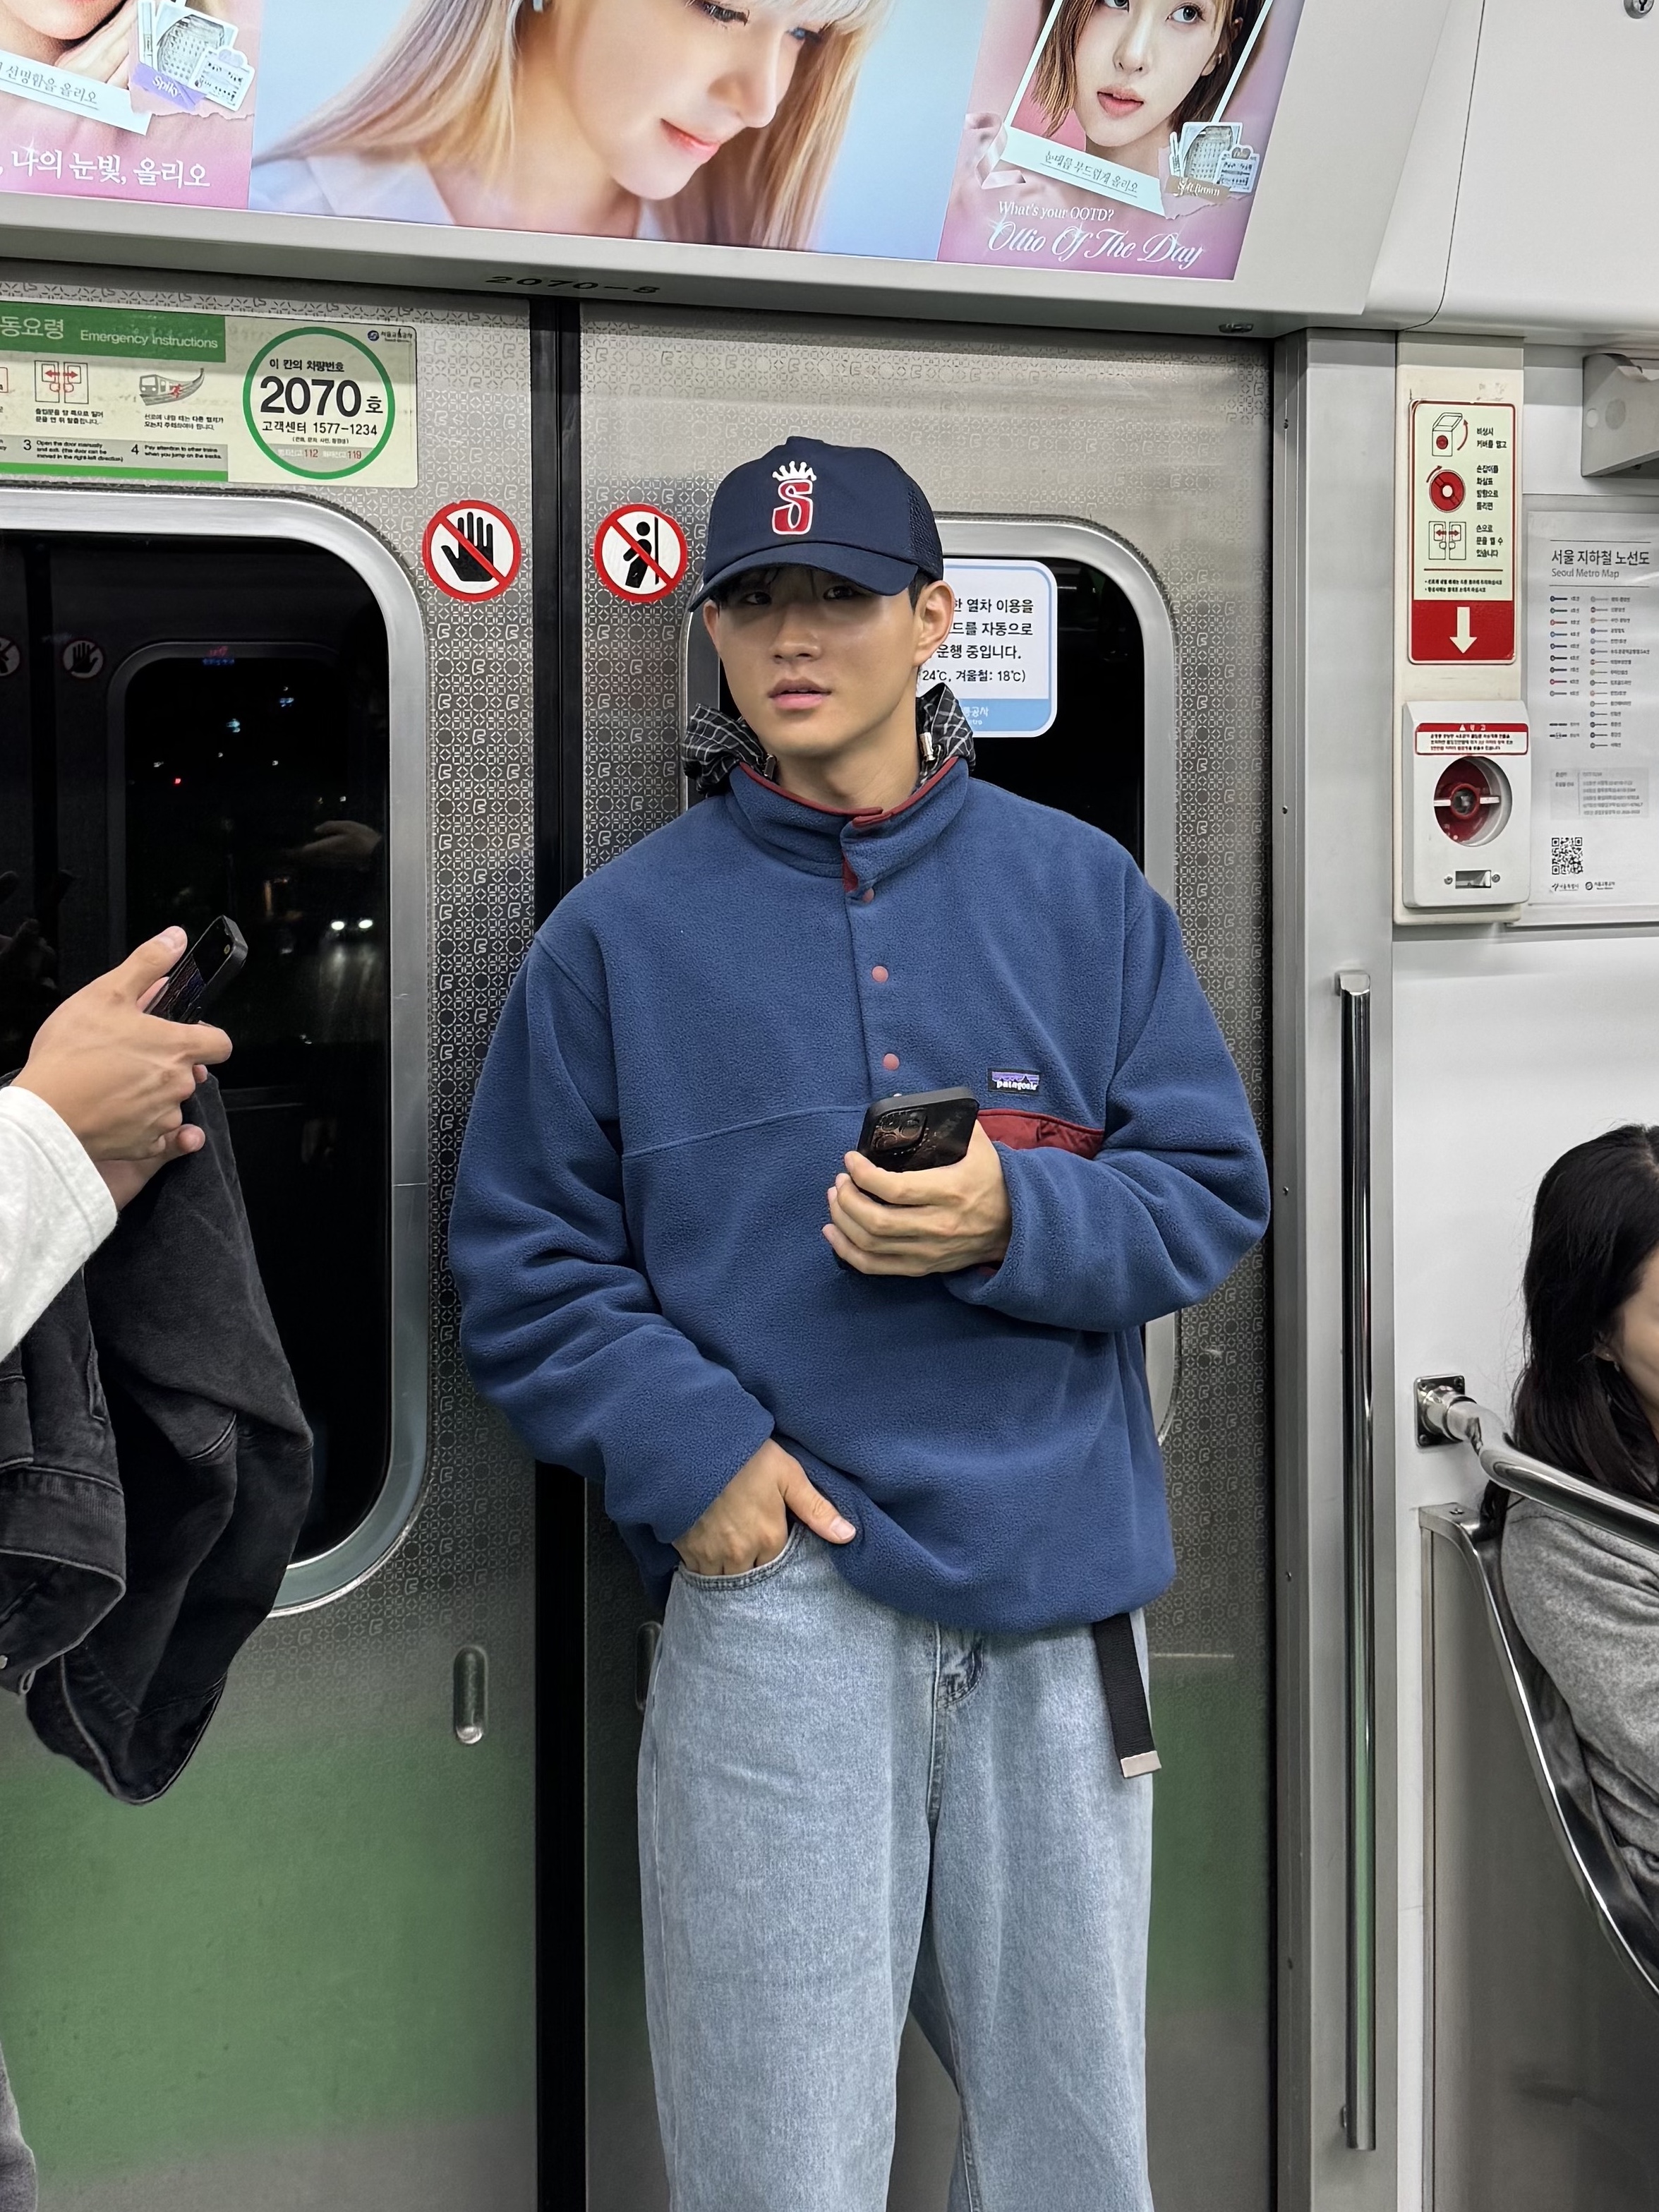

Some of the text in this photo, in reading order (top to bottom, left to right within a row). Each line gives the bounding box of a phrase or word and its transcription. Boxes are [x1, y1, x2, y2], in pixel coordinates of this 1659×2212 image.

[59, 83, 97, 104] 올리오
[11, 149, 210, 188] 나의 눈빛, 올리오
[1111, 176, 1138, 193] 올리오
[999, 201, 1114, 221] What's your OOTD?
[1051, 226, 1094, 261] Of
[1084, 228, 1136, 258] The
[1137, 233, 1204, 270] Day
[0, 316, 64, 340] 동요령
[80, 330, 218, 349] Emergency Instructions
[270, 359, 344, 372] 이 칸의 차량번호
[260, 375, 384, 417] 2070 호
[262, 421, 378, 435] 고객센터 1577-1234
[23, 439, 32, 450] 3
[131, 444, 140, 455] 4
[305, 449, 318, 458] 112
[348, 450, 362, 459] 119
[772, 479, 813, 535] S
[1552, 549, 1650, 565] 서울 지하철 노선도
[1552, 568, 1619, 579] Seoul Metro Map
[967, 599, 992, 613] 열차
[996, 599, 1034, 613] 이용을
[982, 622, 1034, 636] 자동으로
[936, 644, 1022, 659] 운행 중입니다.
[955, 670, 993, 682] 겨울철:
